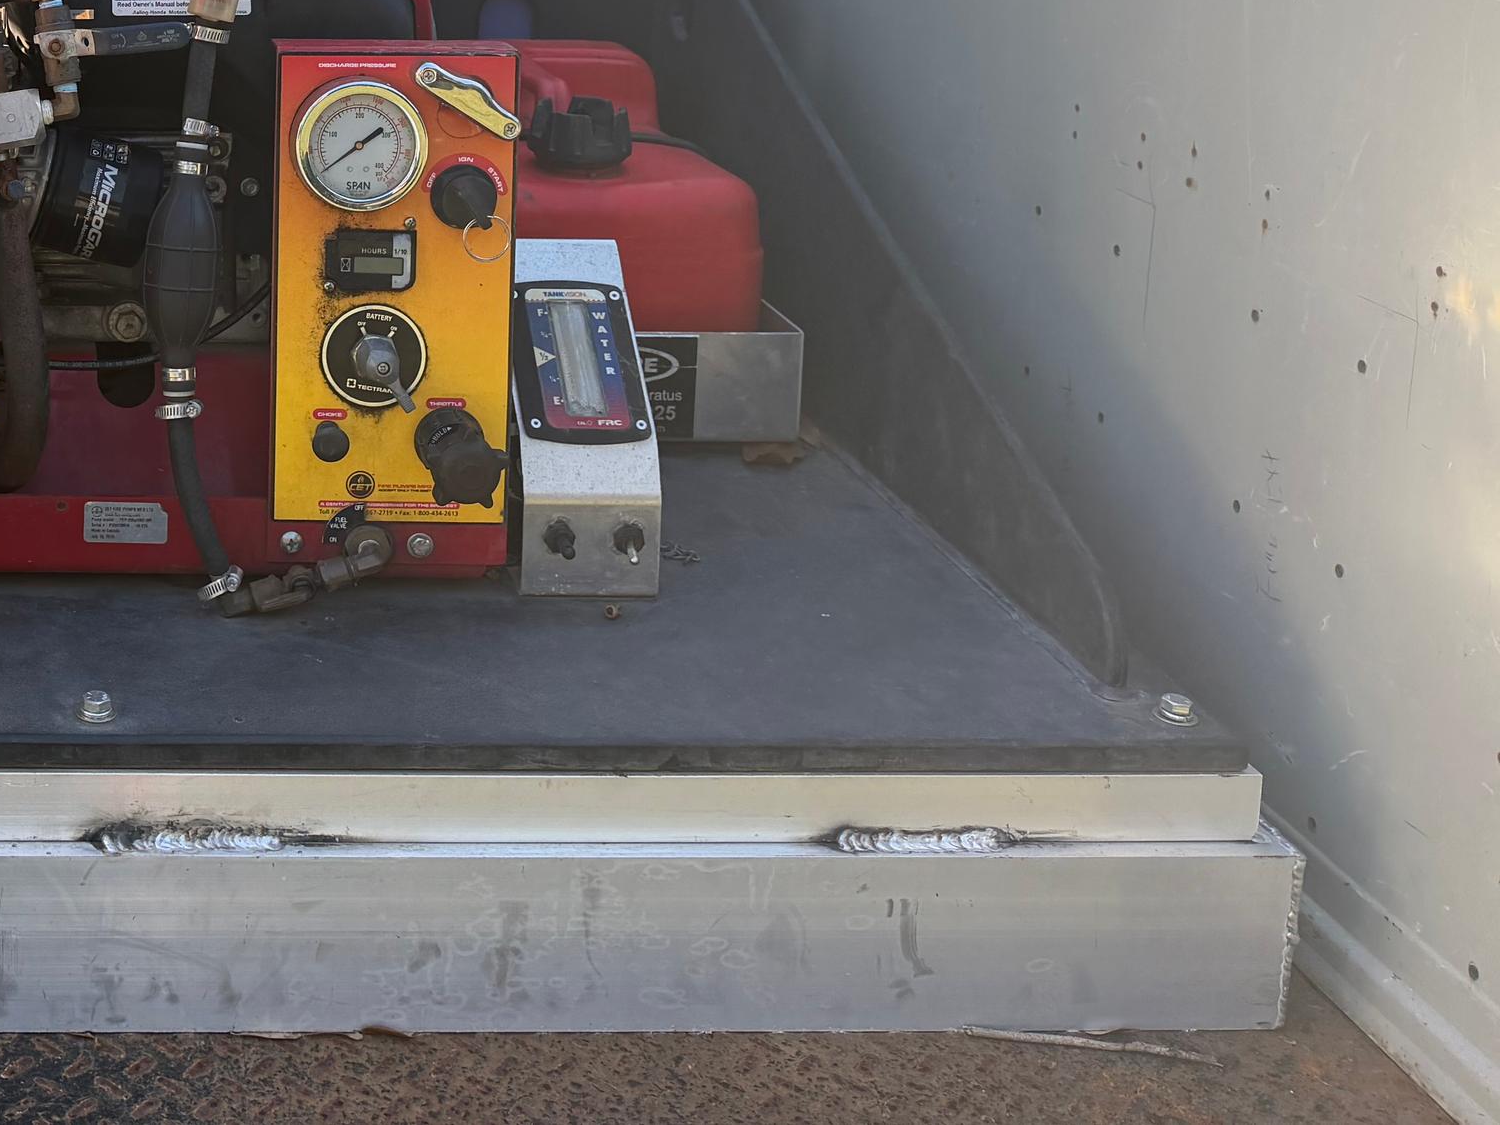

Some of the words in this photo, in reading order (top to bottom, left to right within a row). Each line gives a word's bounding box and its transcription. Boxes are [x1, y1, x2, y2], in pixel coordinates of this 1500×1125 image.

[346, 181, 371, 190] SPAN
[426, 172, 436, 188] OFF
[487, 167, 504, 193] START
[82, 163, 119, 259] MICROGAR
[361, 247, 387, 255] HOURS
[366, 313, 393, 322] BATTERY
[591, 311, 616, 375] WATER
[648, 389, 683, 402] ratus
[350, 483, 372, 491] CET
